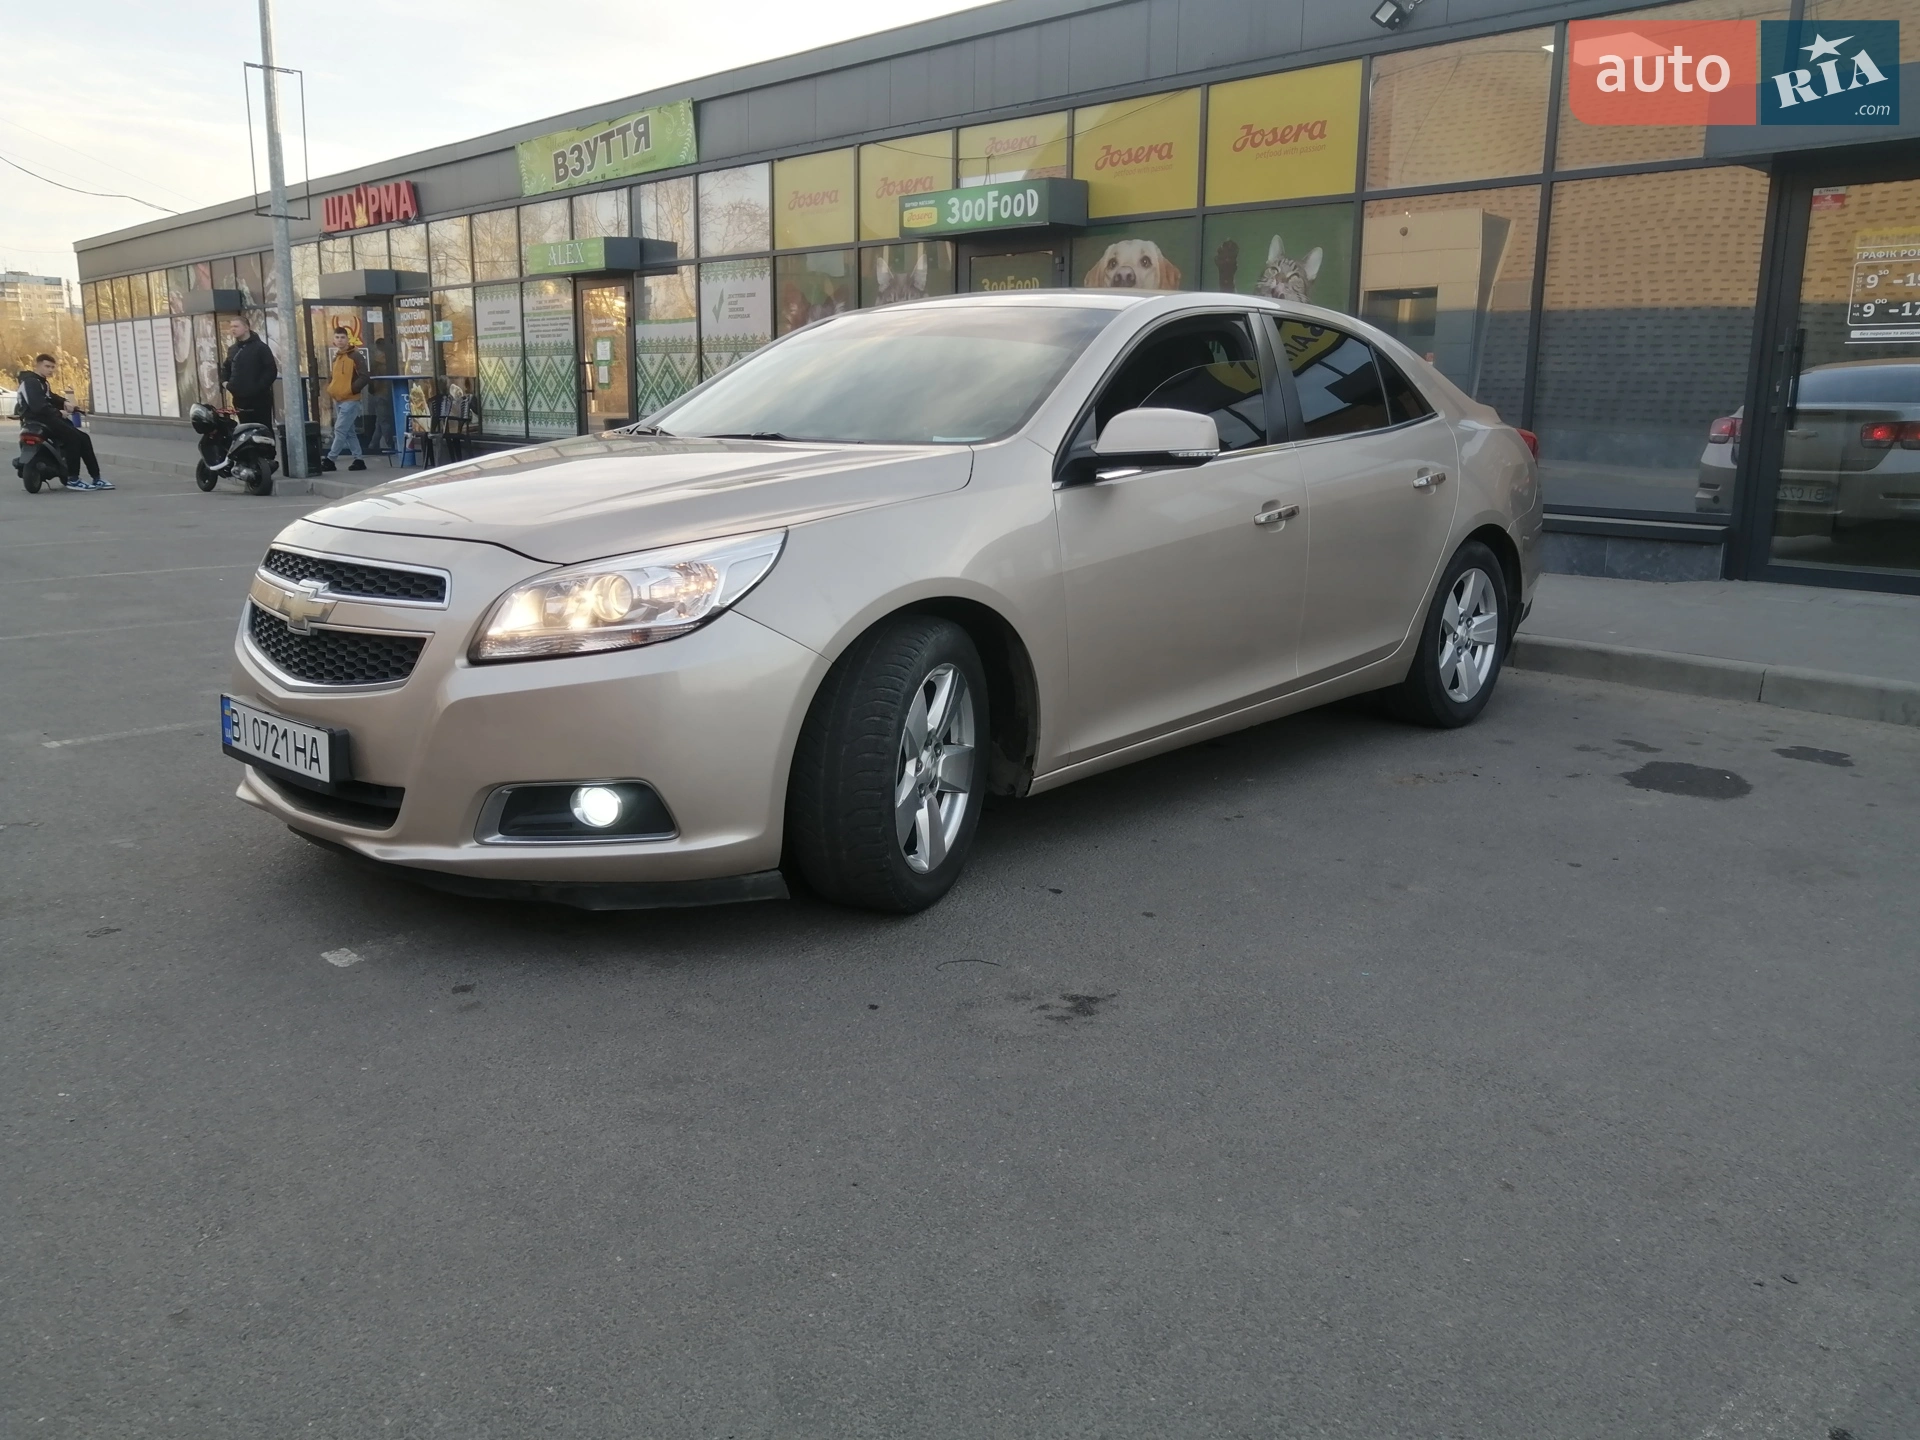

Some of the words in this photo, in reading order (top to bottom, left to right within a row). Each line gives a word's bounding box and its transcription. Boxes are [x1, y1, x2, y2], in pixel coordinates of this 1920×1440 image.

[985, 135, 1037, 155] Josera
[1233, 120, 1328, 152] Josera
[552, 114, 652, 186] ВЗУТТЯ
[1094, 142, 1173, 171] Josera
[1255, 148, 1282, 160] petfood
[1284, 146, 1298, 156] with
[1300, 144, 1326, 156] passion
[875, 176, 934, 199] Josera
[788, 189, 839, 211] Josera
[906, 211, 933, 223] Josera
[547, 242, 585, 266] ALEX
[1856, 250, 1898, 260] ГРАФІК
